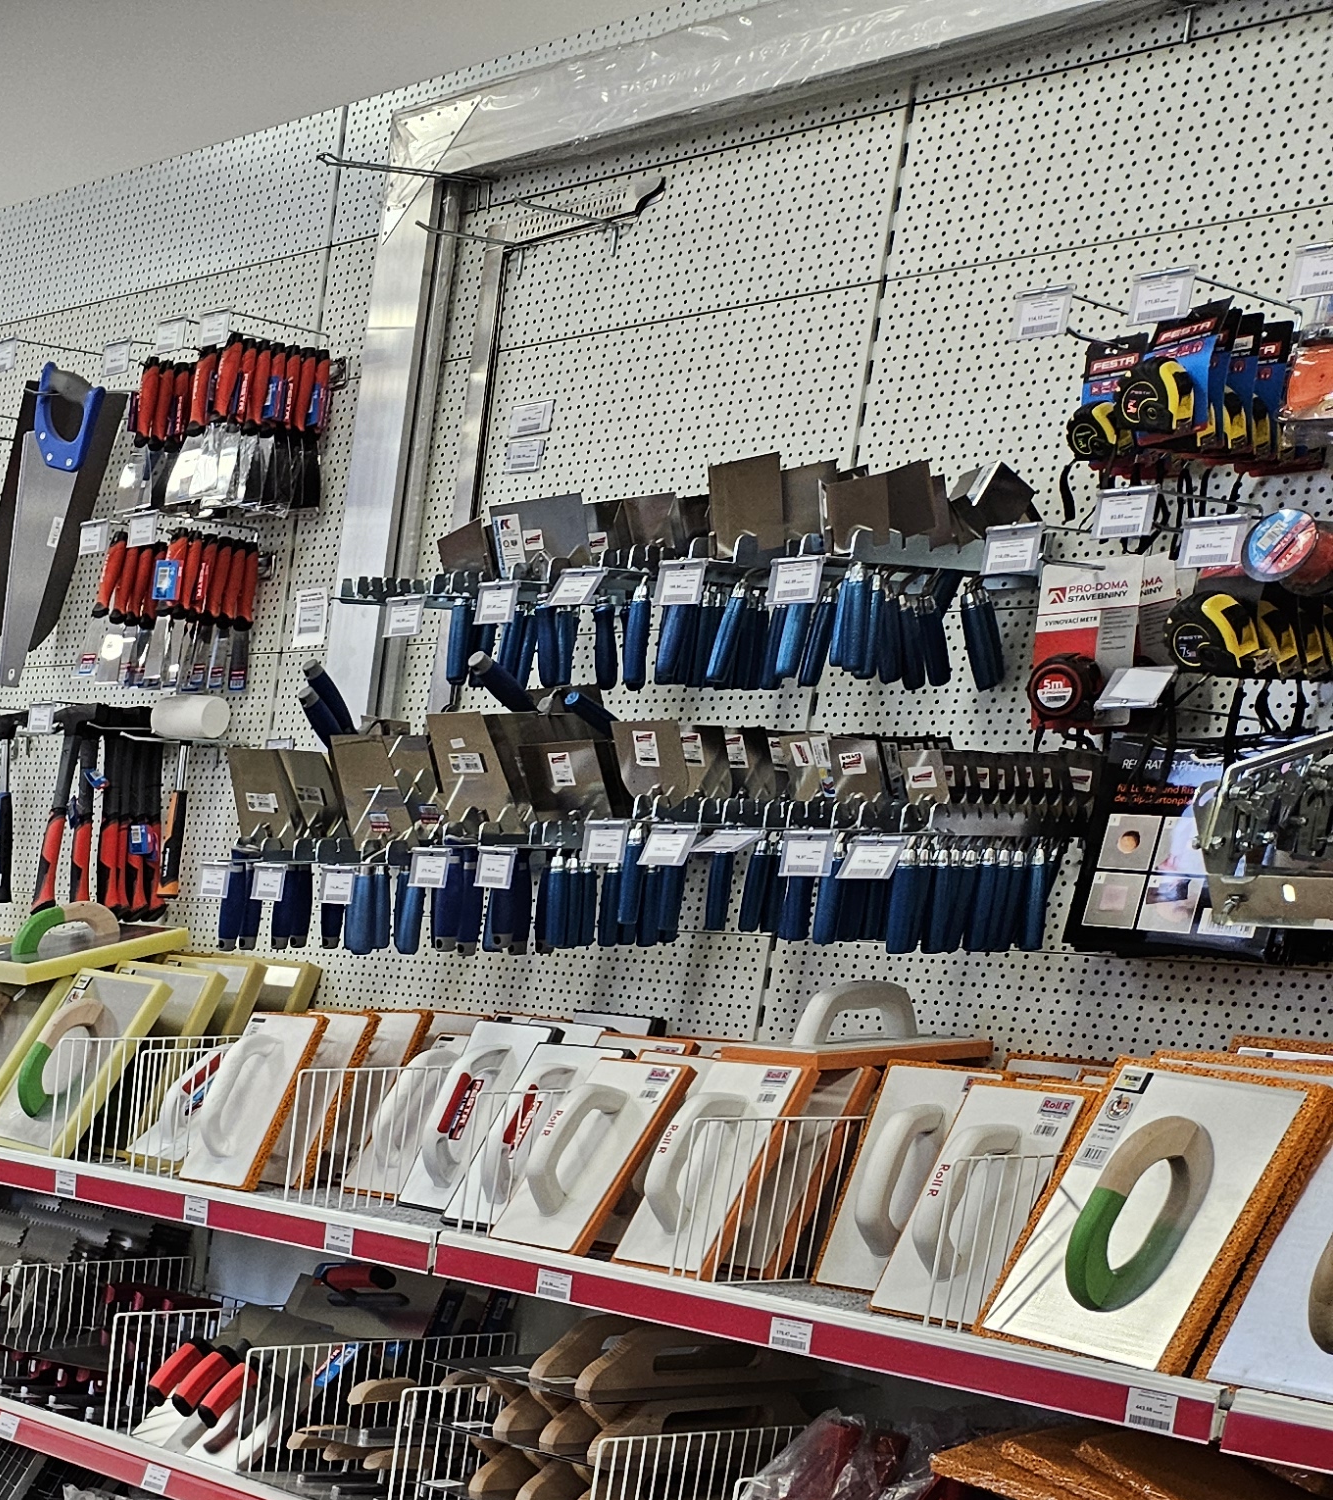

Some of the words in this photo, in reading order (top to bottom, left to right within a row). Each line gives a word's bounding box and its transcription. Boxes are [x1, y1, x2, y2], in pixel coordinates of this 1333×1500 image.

[1160, 321, 1213, 341] FESTA
[1092, 356, 1137, 373] FESTA
[1069, 580, 1129, 593] PRO-DOMA
[1067, 590, 1129, 603] STAVEBNINY
[1043, 679, 1064, 690] 5m
[1042, 1099, 1062, 1109] Roll
[1062, 1101, 1071, 1110] R
[547, 1109, 564, 1128] Roll
[662, 1124, 679, 1144] Roll
[657, 1146, 667, 1154] R
[932, 1164, 951, 1187] Roll
[926, 1188, 940, 1197] R
